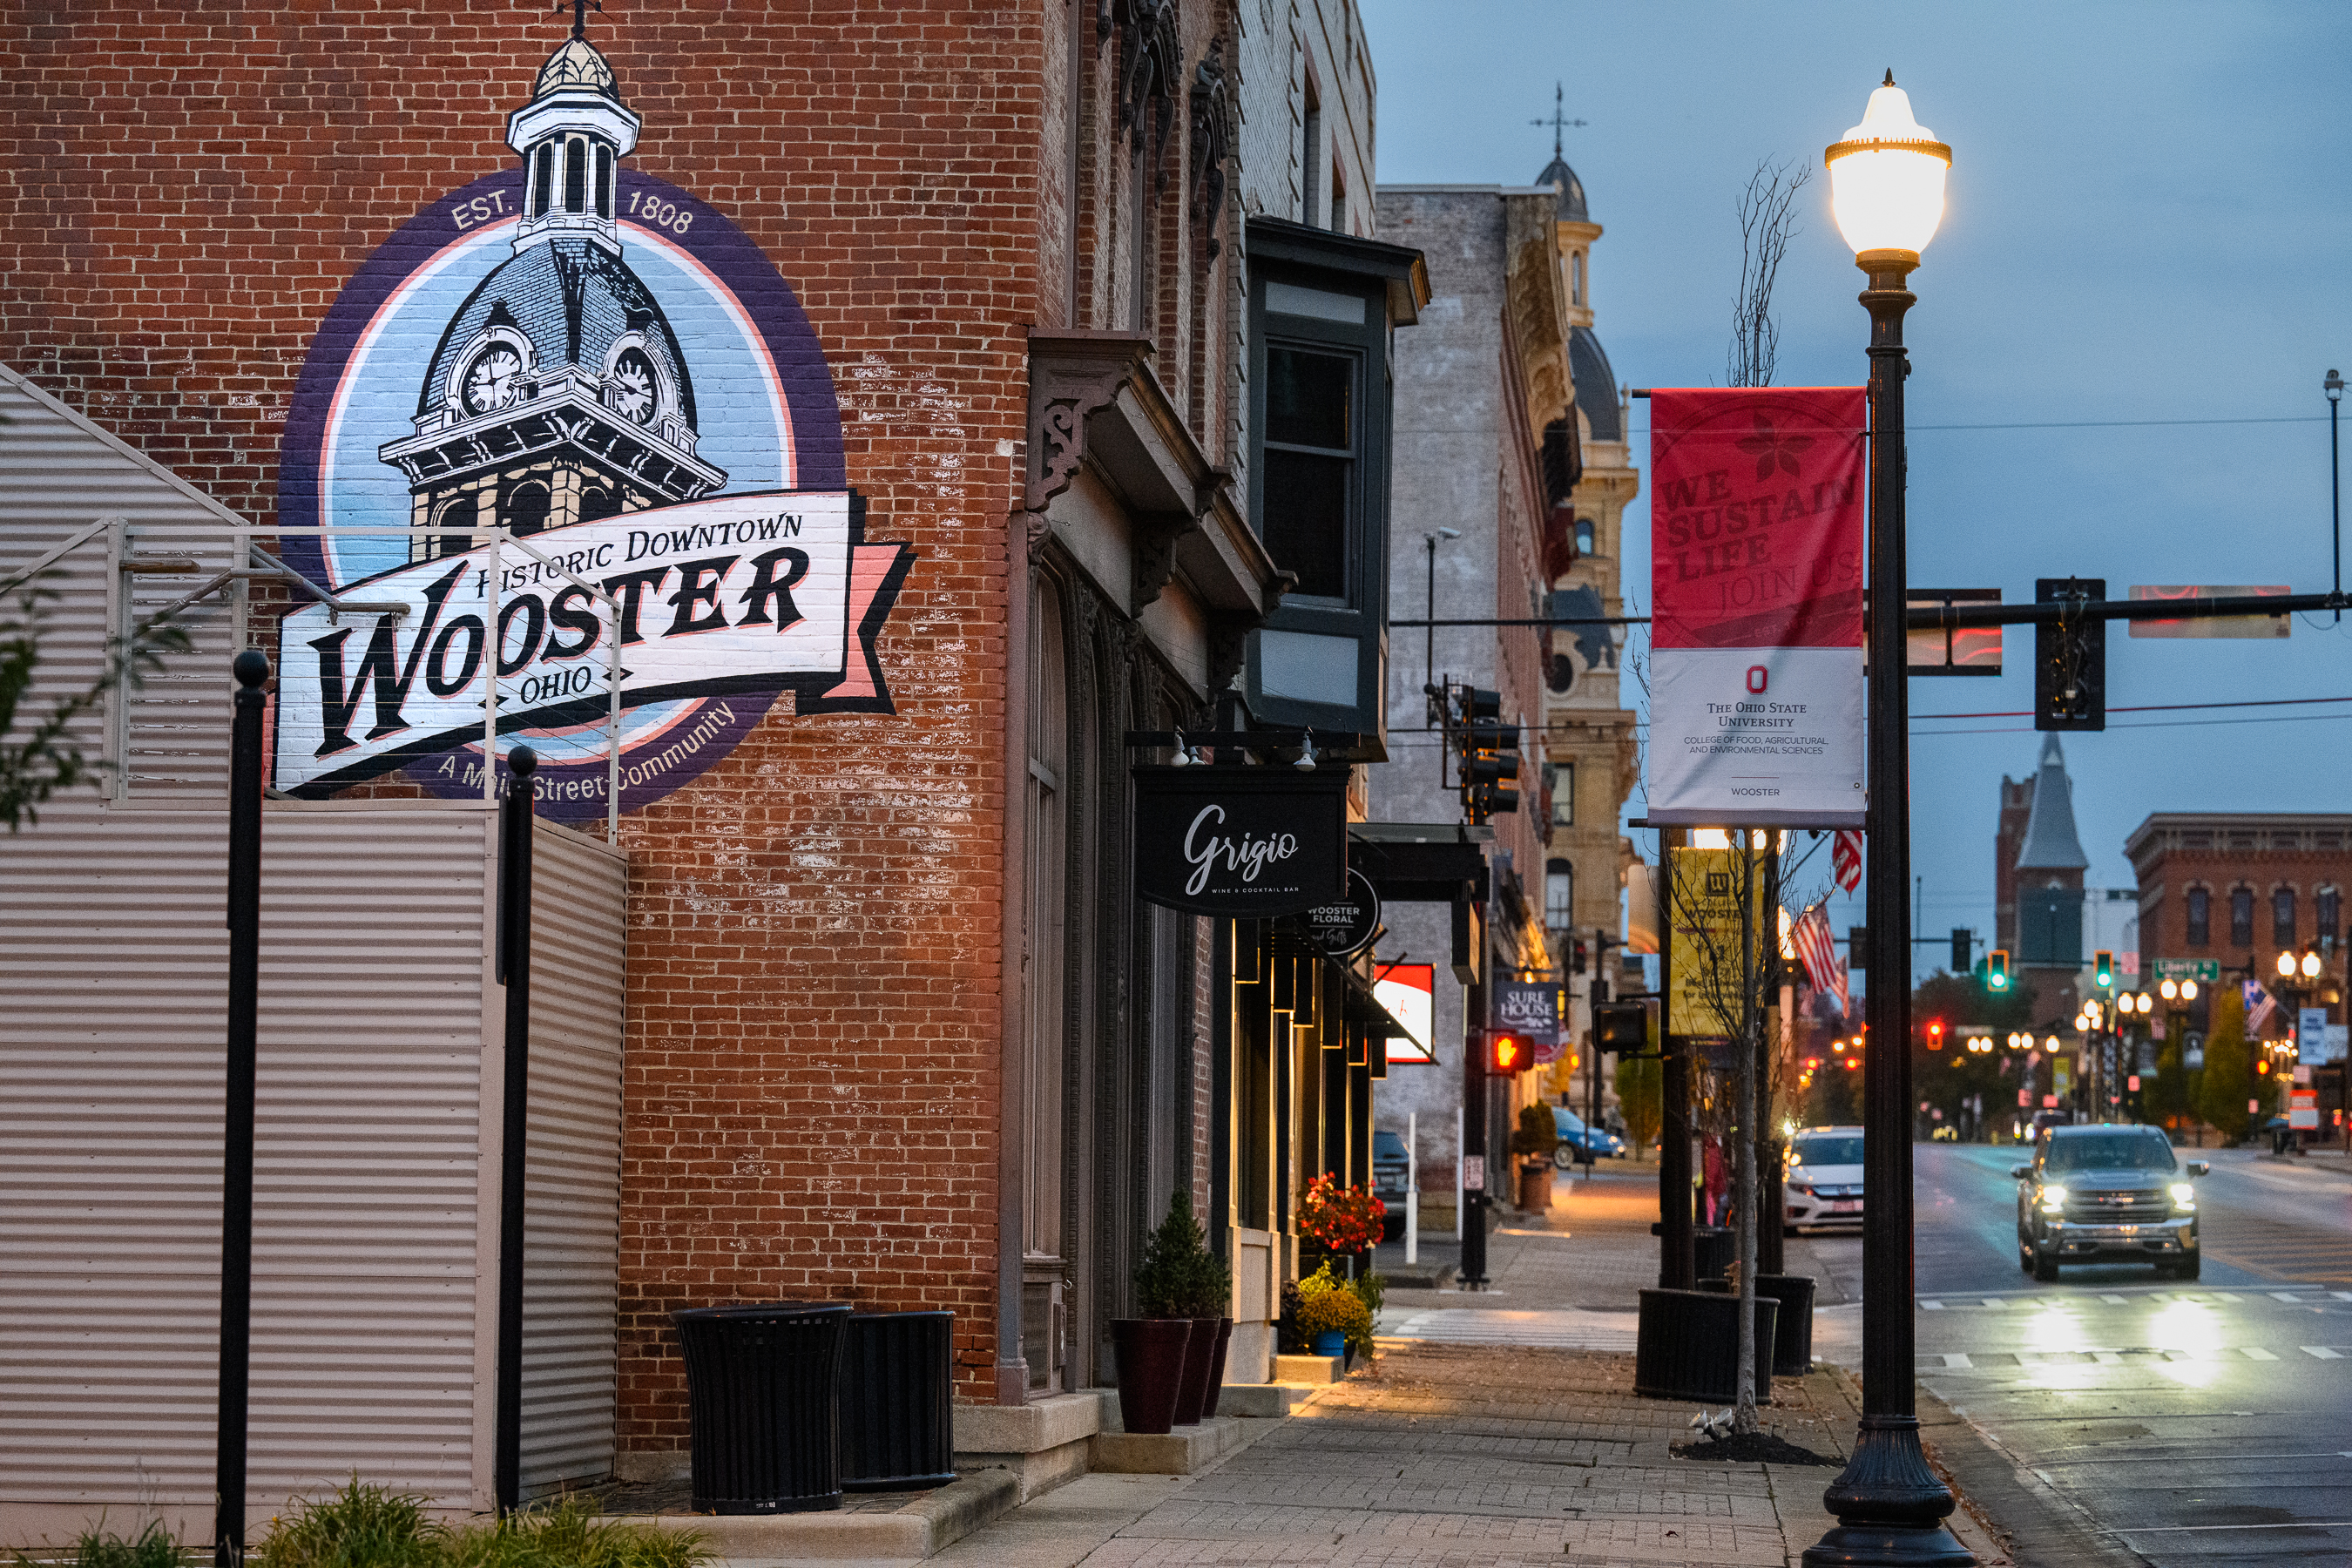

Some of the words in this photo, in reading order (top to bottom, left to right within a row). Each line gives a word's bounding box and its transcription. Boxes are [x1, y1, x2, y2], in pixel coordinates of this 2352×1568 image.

[451, 189, 513, 231] EST.
[628, 191, 693, 234] 1808
[1659, 469, 1733, 512] WE
[1667, 474, 1856, 548] SUSTAIN
[1674, 532, 1773, 583] LIFE
[1719, 564, 1798, 618] JOIN
[1812, 551, 1856, 588] US
[520, 666, 591, 705] OHIO
[1707, 703, 1732, 713] THE
[1735, 701, 1766, 713] OHIO
[1769, 702, 1807, 713] STATE
[1719, 716, 1794, 727] UNIVERSITY
[1684, 736, 1721, 745] COLLEGE
[1736, 736, 1763, 745] FOOD,
[1765, 736, 1829, 746] AGRICULTURAL,
[1709, 746, 1780, 754] ENVIRONMENTAL
[1781, 747, 1823, 755] SCIENCES
[438, 755, 456, 779] A
[532, 775, 606, 801] Street
[1731, 787, 1781, 796] WOOSTER
[1184, 804, 1299, 896] Grigio
[1308, 906, 1361, 916] WOOSTER
[1686, 909, 1743, 919] WOOSTE
[1313, 915, 1355, 923] FLORAL
[1507, 990, 1547, 1004] SURE
[1500, 1003, 1552, 1017] HOUSE
